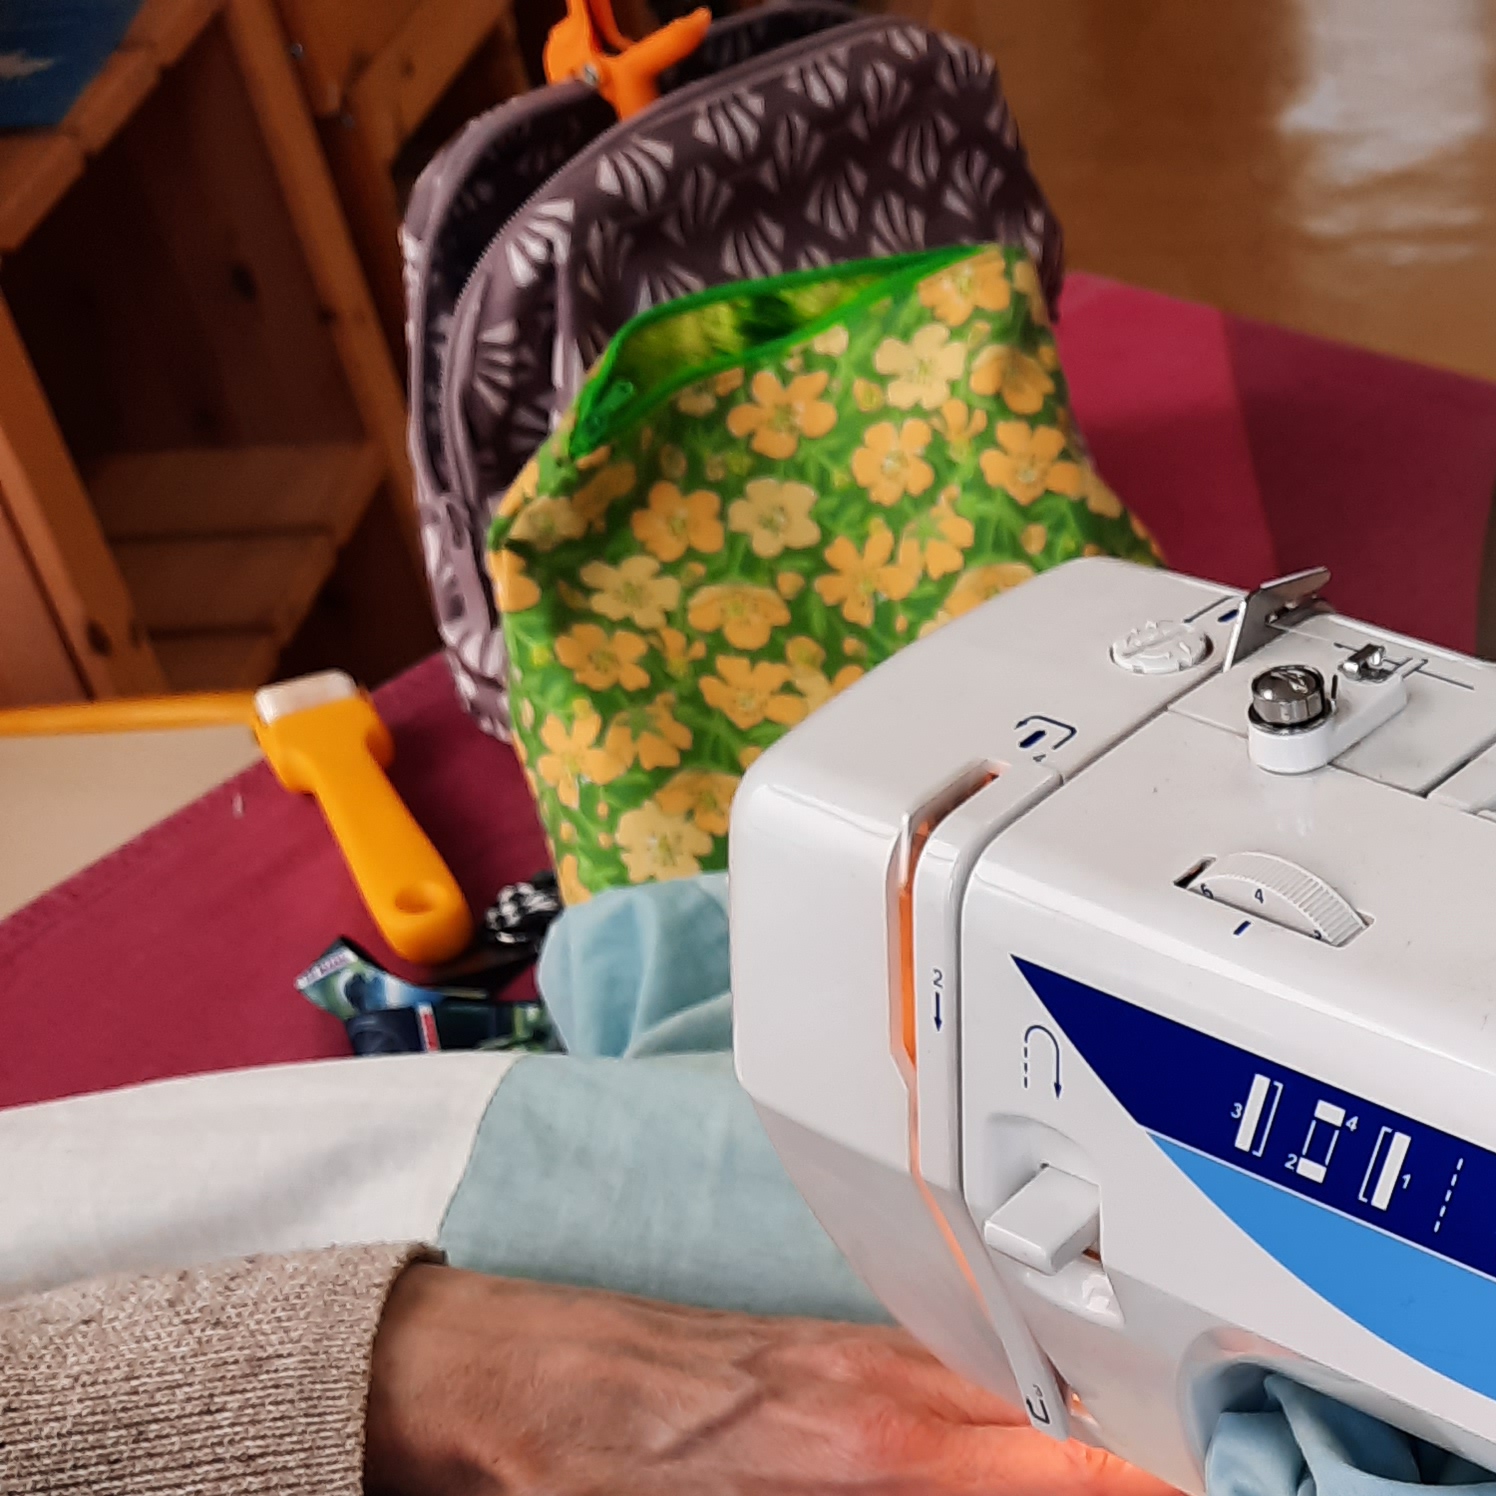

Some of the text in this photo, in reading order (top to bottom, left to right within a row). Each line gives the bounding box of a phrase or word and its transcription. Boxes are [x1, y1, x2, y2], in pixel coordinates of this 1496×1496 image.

[933, 968, 943, 989] 2
[1231, 1102, 1243, 1119] 3
[1345, 1116, 1359, 1132] 4
[1284, 1153, 1298, 1172] 2
[1402, 1174, 1411, 1189] 1
